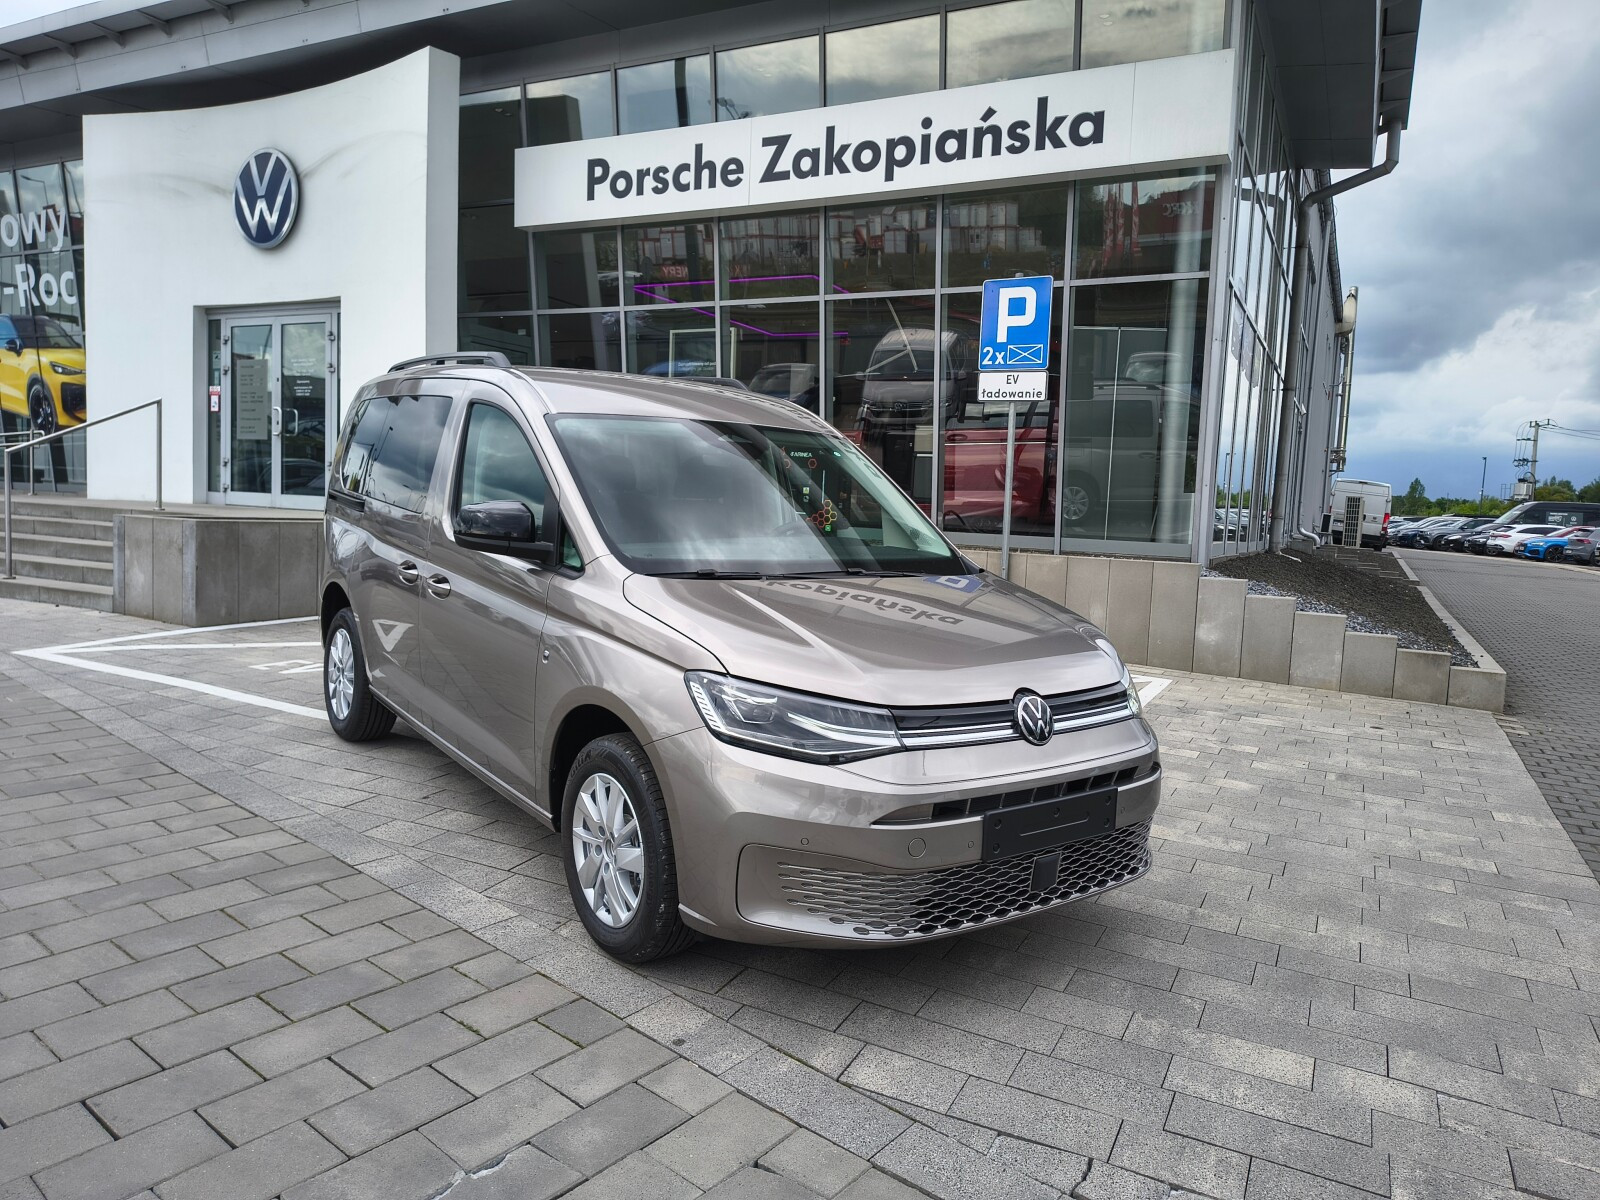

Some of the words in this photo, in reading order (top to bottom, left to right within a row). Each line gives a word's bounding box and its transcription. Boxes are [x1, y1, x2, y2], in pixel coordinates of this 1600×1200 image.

[587, 144, 743, 200] Porsche
[759, 96, 1104, 183] Zakopiańska
[3, 263, 77, 307] -Roc
[996, 286, 1037, 343] P
[981, 346, 1005, 365] 2x
[981, 388, 1042, 398] ładowanie
[1006, 374, 1019, 385] EV
